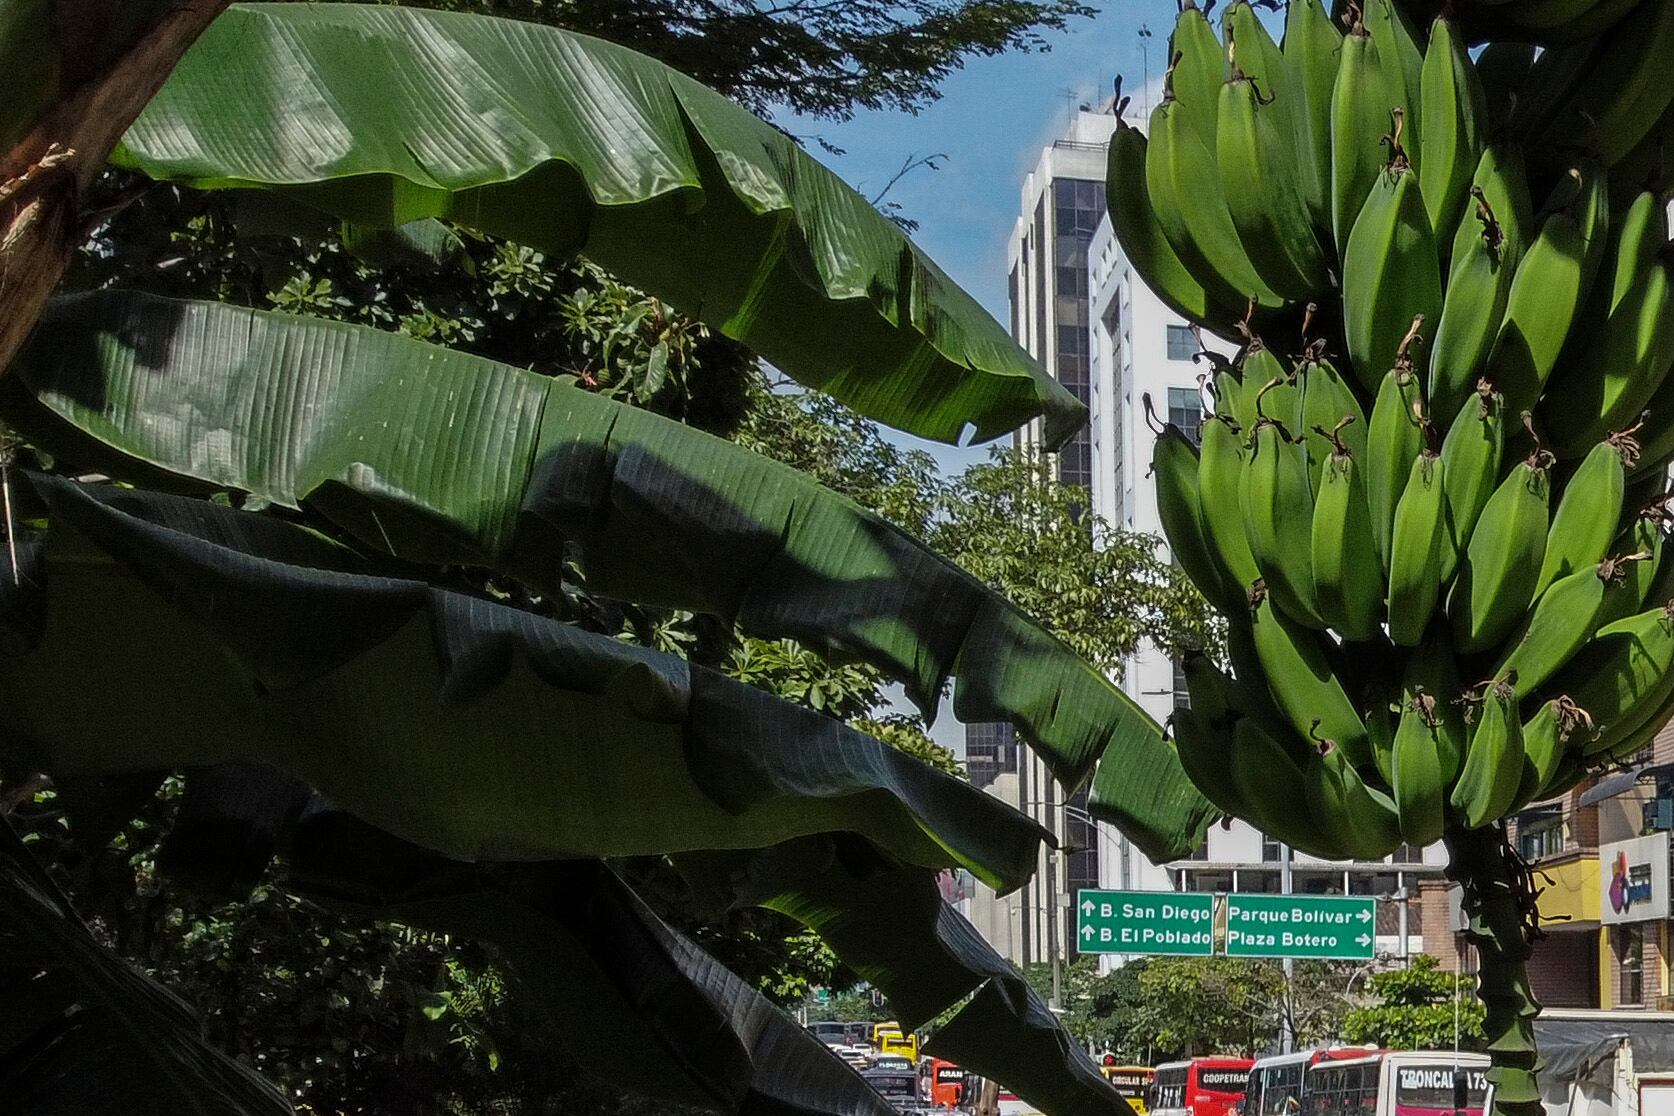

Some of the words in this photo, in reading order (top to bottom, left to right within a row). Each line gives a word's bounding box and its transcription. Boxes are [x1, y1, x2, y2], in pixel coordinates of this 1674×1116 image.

[1100, 903, 1118, 918] B.
[1122, 904, 1155, 919] San
[1162, 904, 1211, 924] Diego
[1228, 906, 1289, 924] Parque
[1291, 907, 1353, 924] Bolívar
[1100, 928, 1118, 942] B.
[1121, 928, 1139, 943] El
[1142, 930, 1212, 945] Poblado
[1228, 930, 1276, 946] Plaza
[1281, 931, 1338, 947] Botero
[1400, 1070, 1455, 1089] TRONCAL
